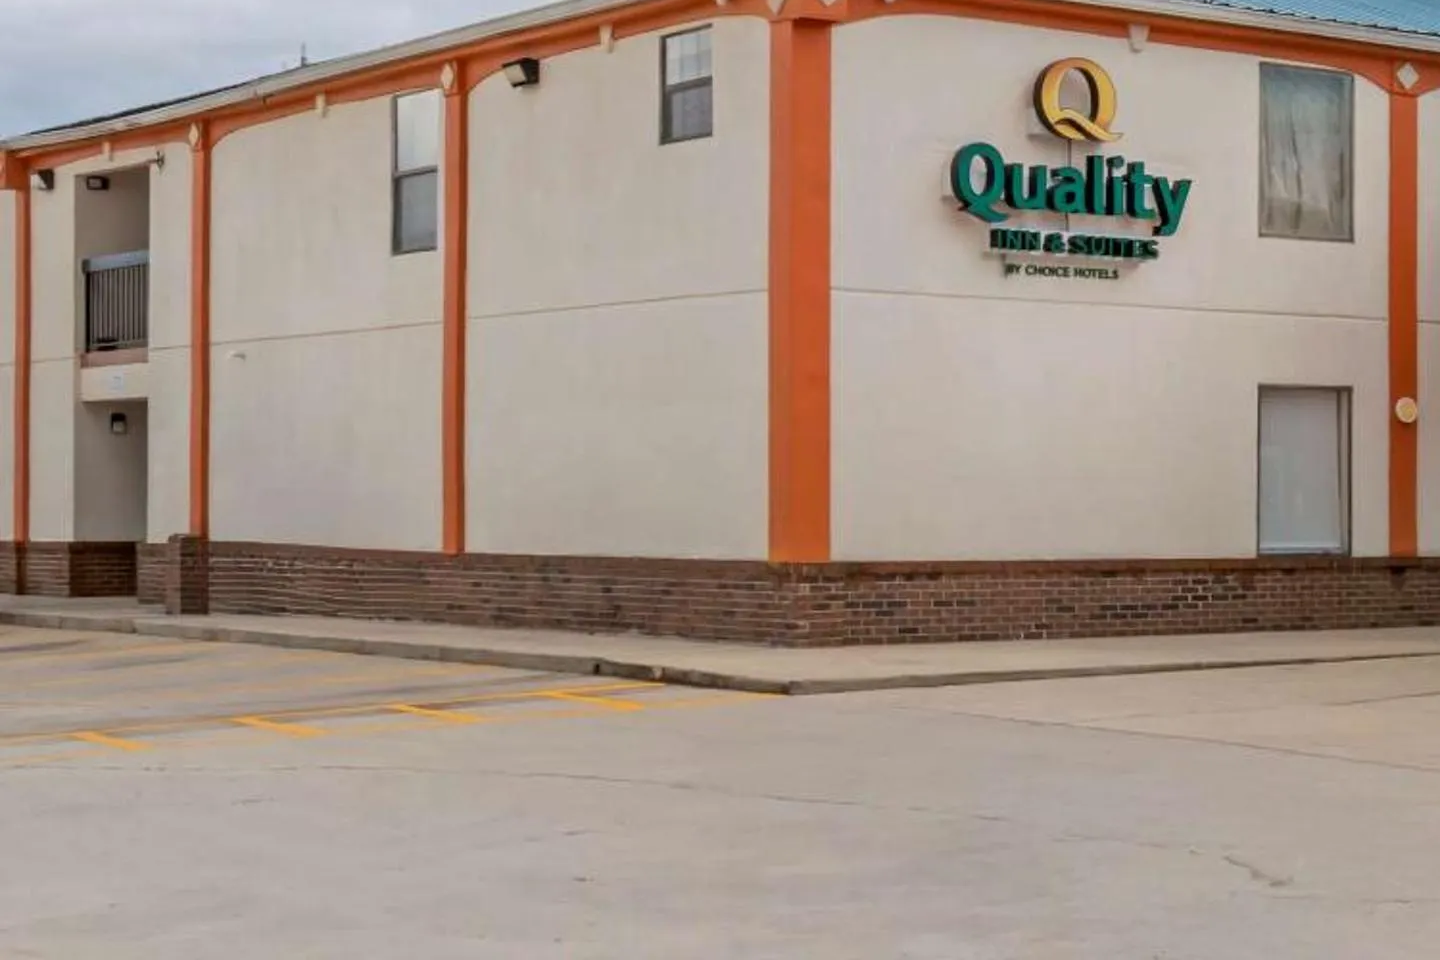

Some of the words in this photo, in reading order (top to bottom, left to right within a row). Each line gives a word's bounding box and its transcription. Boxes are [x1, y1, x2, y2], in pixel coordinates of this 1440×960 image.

[1033, 56, 1124, 141] Q
[951, 142, 1192, 237] Quality
[990, 228, 1042, 251] INN
[1043, 232, 1066, 254] &
[1067, 234, 1160, 260] SUITES
[1005, 263, 1021, 275] BY
[1025, 264, 1070, 278] CHOICE
[1073, 266, 1119, 280] HOTELS
